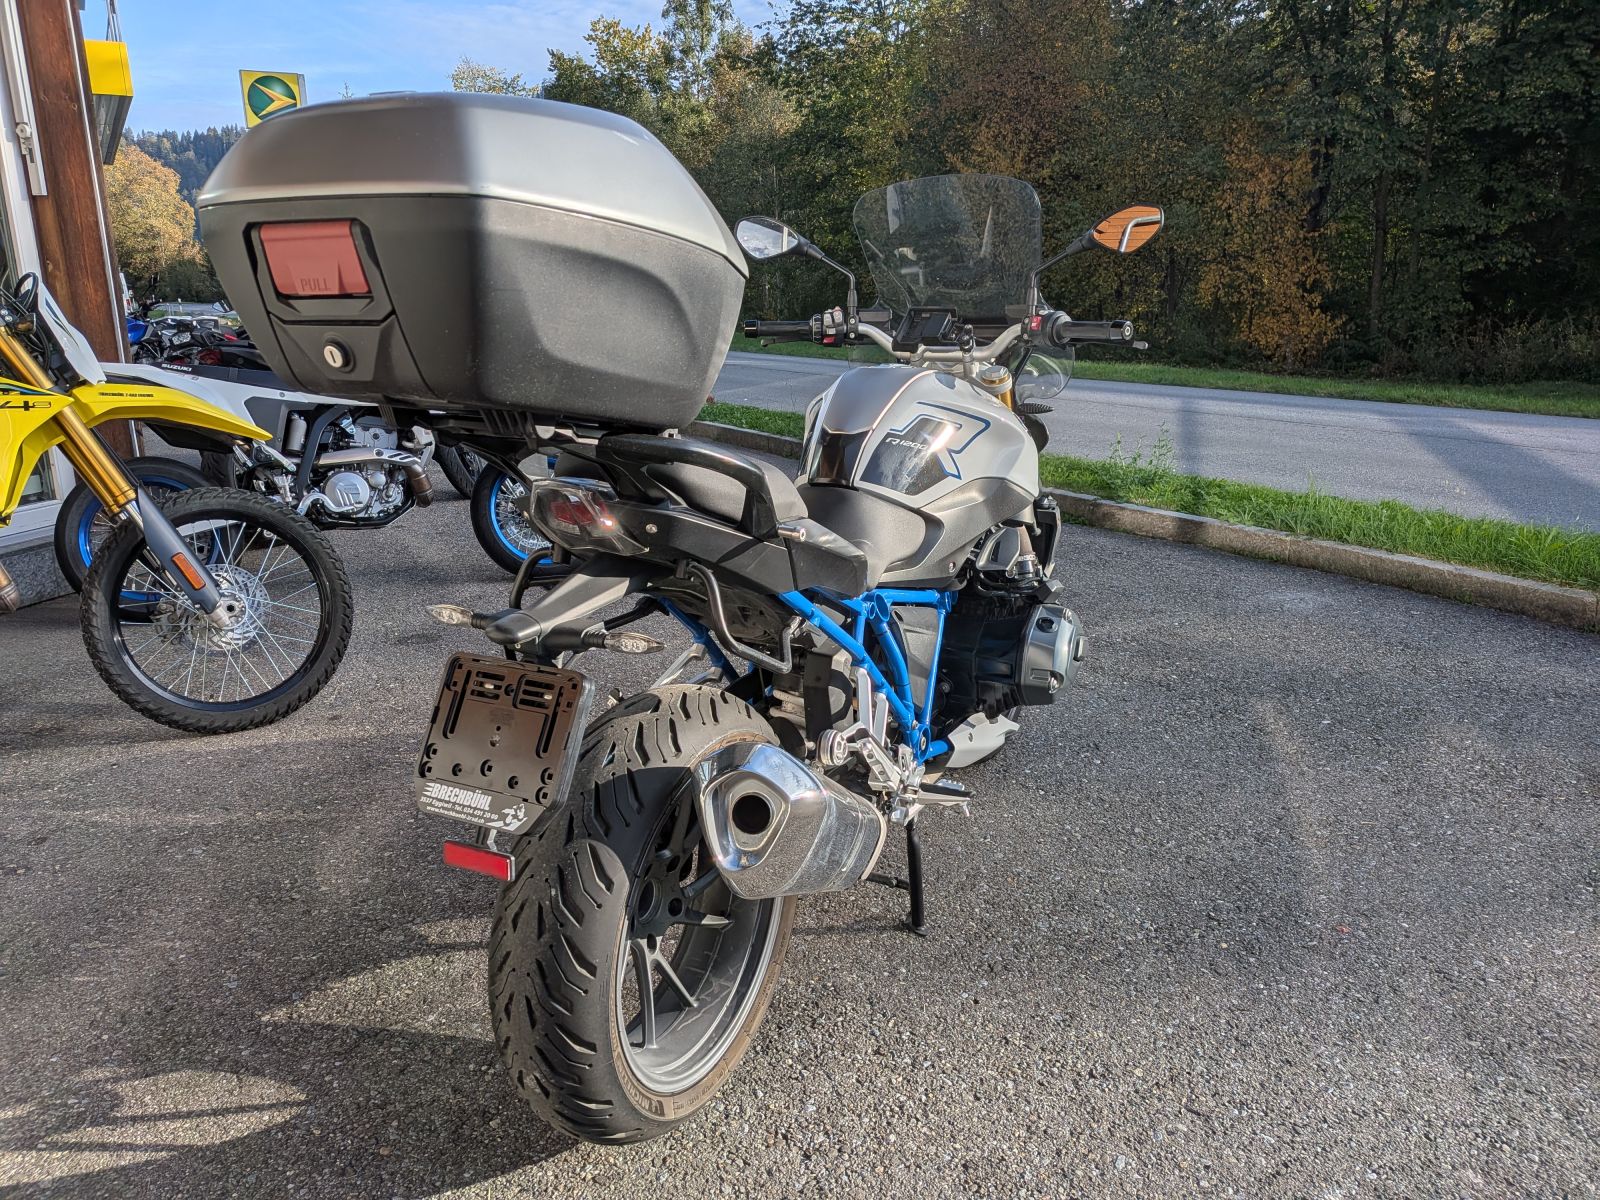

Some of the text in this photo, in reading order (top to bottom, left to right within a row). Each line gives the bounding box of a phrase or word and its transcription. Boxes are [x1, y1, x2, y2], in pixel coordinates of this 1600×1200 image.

[300, 277, 332, 291] PULL
[161, 363, 193, 372] SUZUKI
[430, 783, 492, 811] BRECHBÜHL
